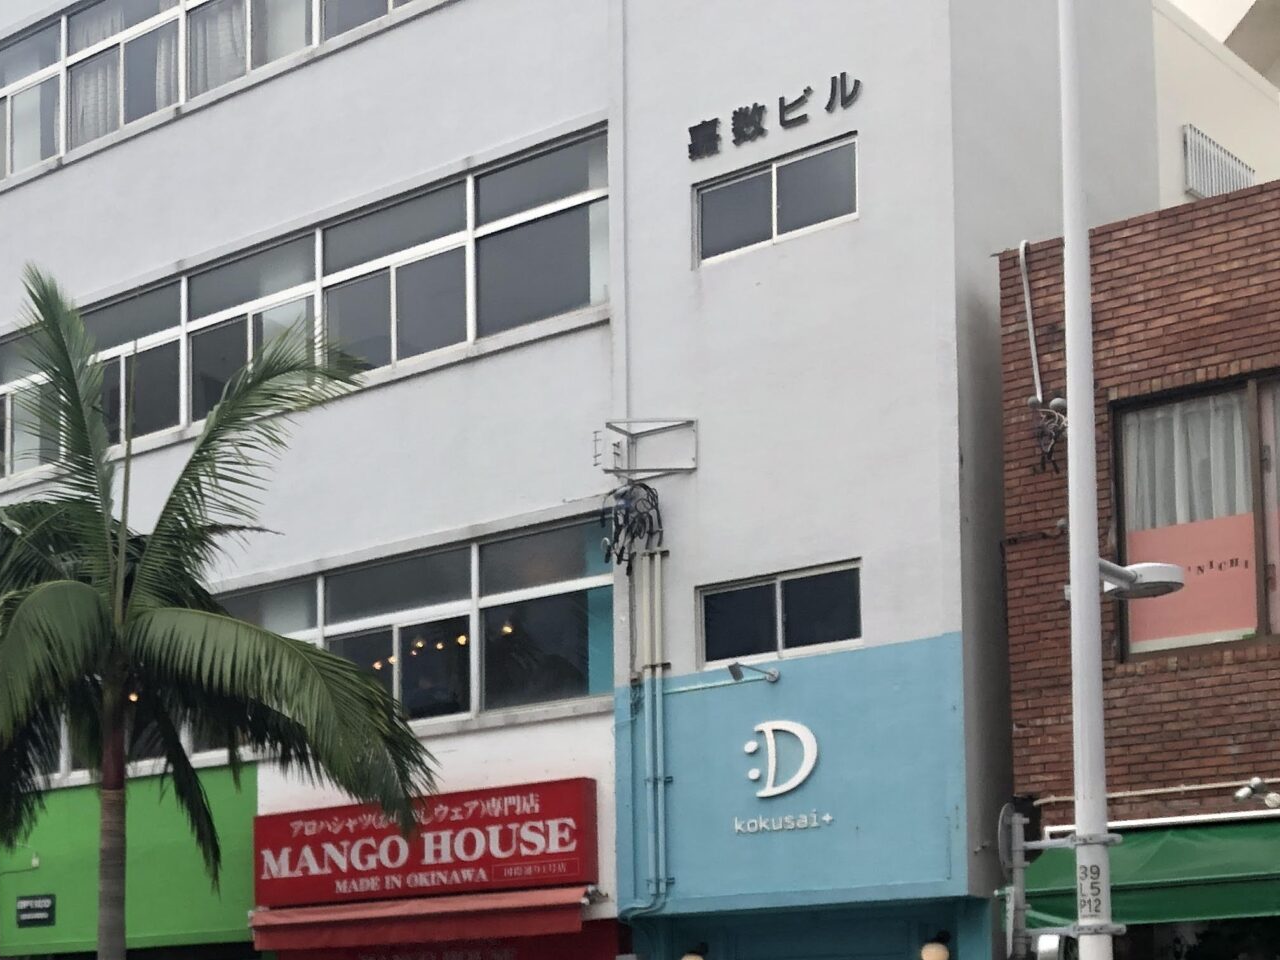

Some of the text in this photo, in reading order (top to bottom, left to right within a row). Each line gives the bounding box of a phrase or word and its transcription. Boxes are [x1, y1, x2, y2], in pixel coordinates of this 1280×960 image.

[1188, 557, 1249, 575] NICHI
[260, 817, 577, 880] MANGO HOUSE
[335, 867, 489, 893] MADE IN OKINAWA
[1079, 864, 1101, 881] 39
